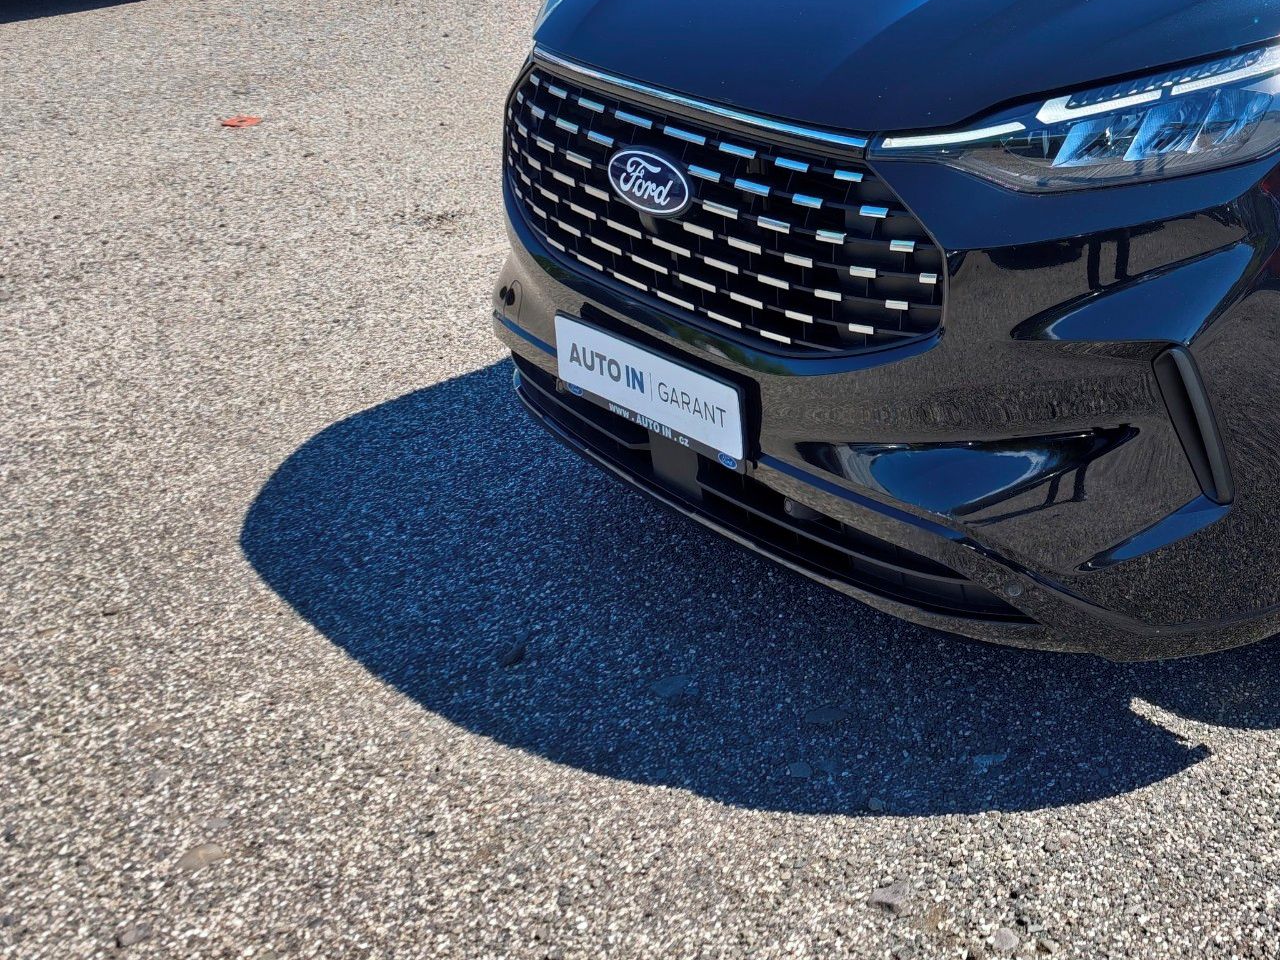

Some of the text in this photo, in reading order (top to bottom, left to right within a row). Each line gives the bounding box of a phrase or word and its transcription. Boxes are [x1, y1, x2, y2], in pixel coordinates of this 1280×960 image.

[620, 157, 673, 206] Ford
[569, 342, 727, 428] AUTO IN GARANT
